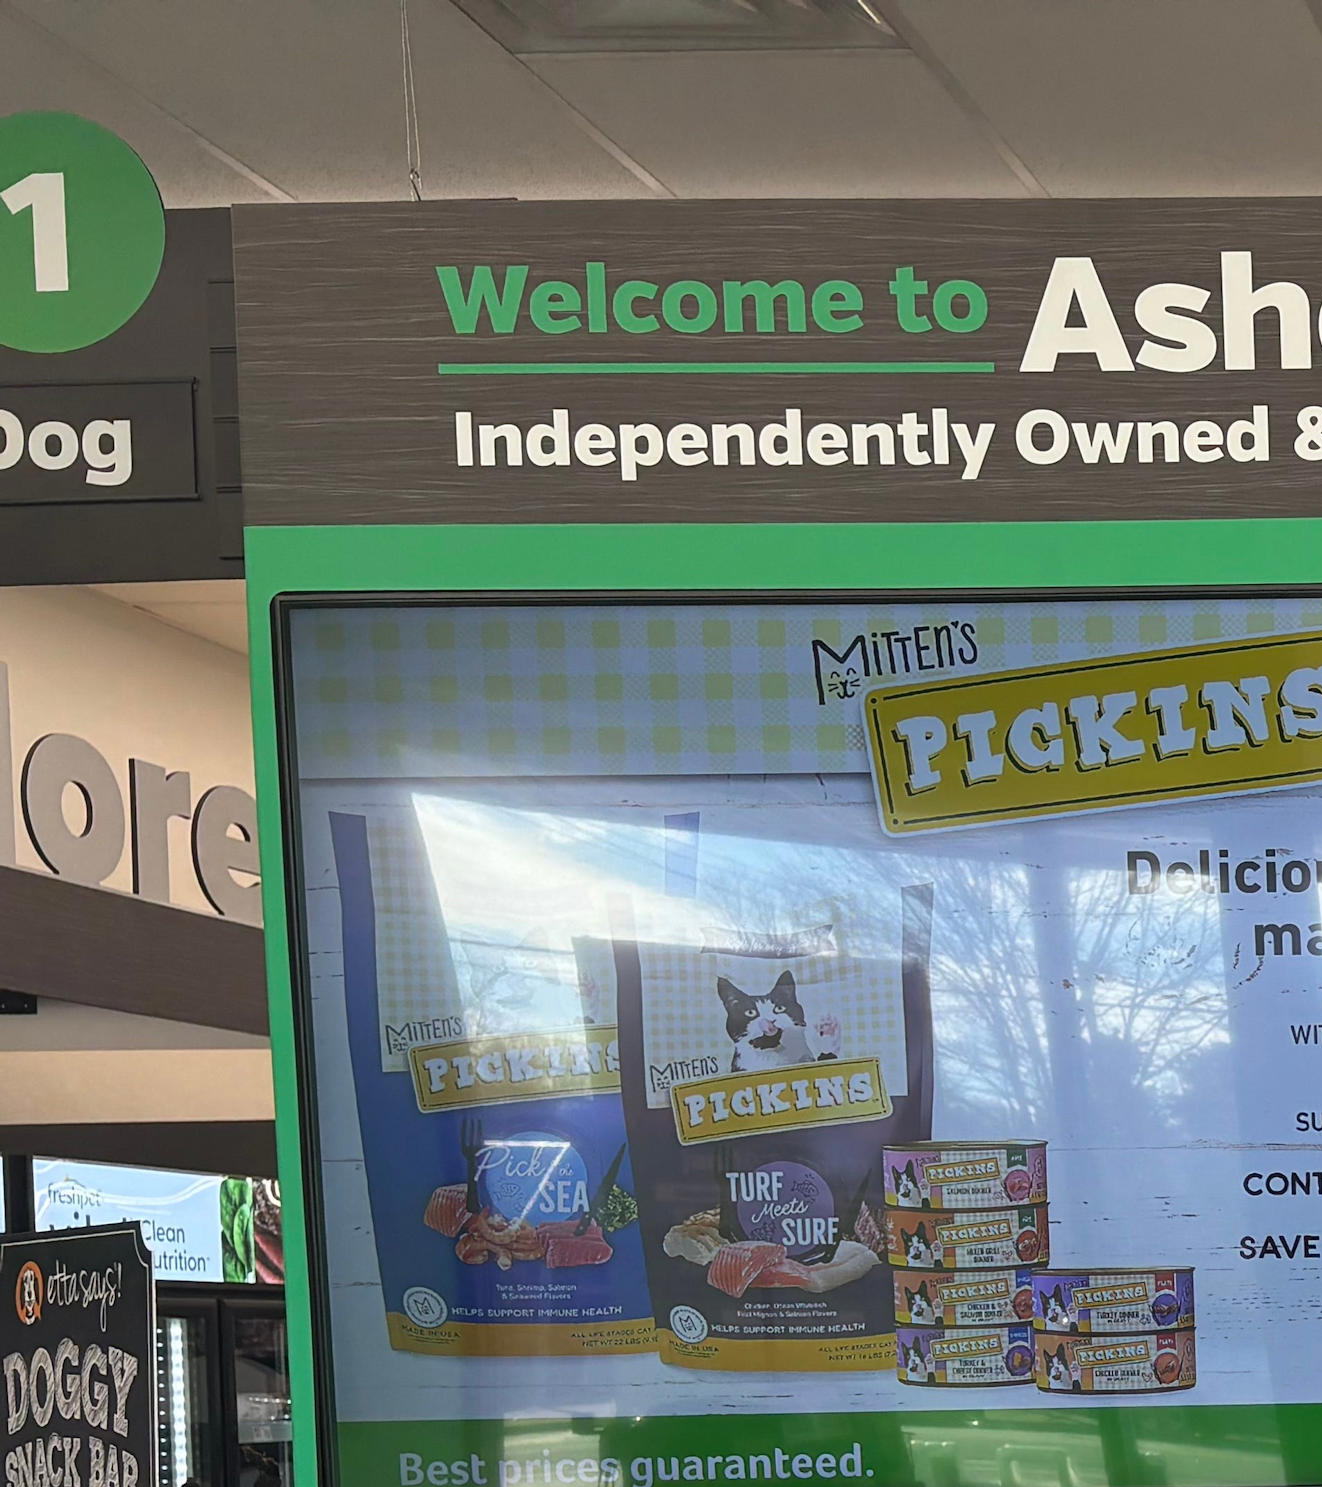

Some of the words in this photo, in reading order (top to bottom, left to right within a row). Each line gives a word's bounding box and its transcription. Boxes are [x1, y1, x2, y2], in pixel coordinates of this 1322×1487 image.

[435, 262, 864, 335] Welcome
[889, 266, 988, 326] to
[455, 408, 996, 481] Independently
[1015, 405, 1270, 466] Owned
[684, 1071, 875, 1127] PICKINS
[726, 1171, 785, 1203] TURF
[782, 1217, 840, 1246] SURF
[1240, 1235, 1320, 1261] SAVE
[3, 1338, 138, 1438] DOGGY
[400, 1453, 487, 1486] Best
[500, 1448, 620, 1487] prices
